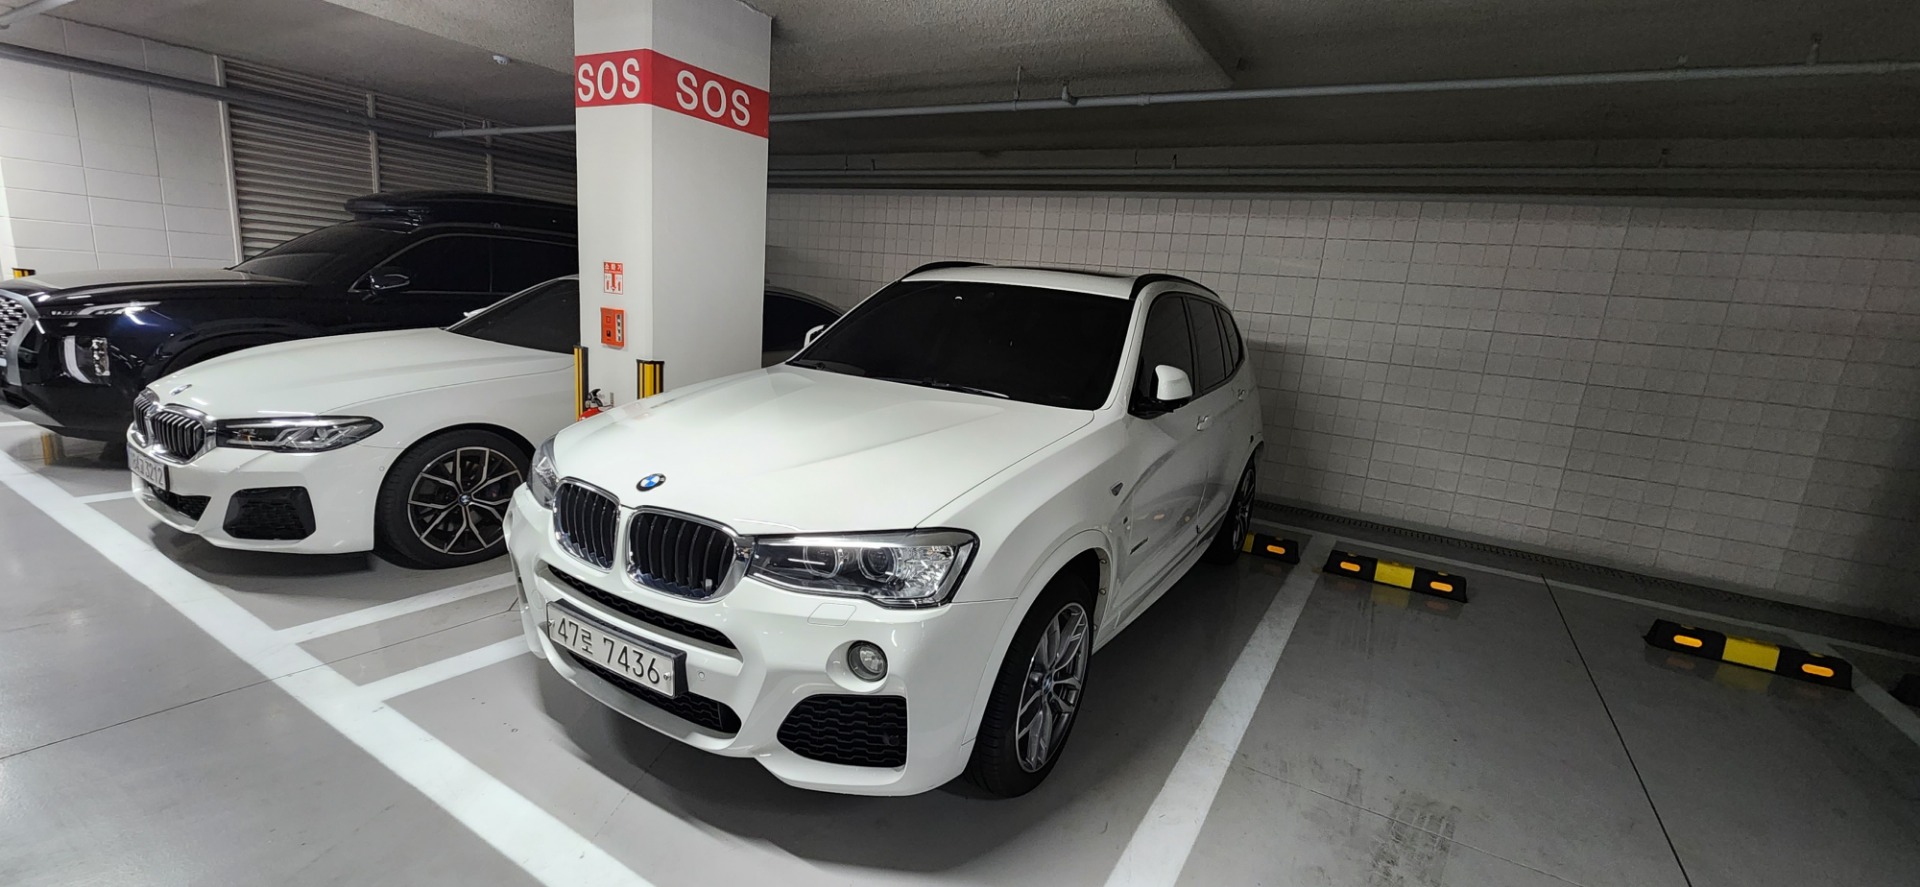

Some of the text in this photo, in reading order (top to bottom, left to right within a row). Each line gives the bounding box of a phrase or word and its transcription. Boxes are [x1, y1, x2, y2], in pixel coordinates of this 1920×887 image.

[578, 57, 641, 102] SOS
[676, 69, 751, 127] SOS
[557, 617, 660, 685] 47로 7436
